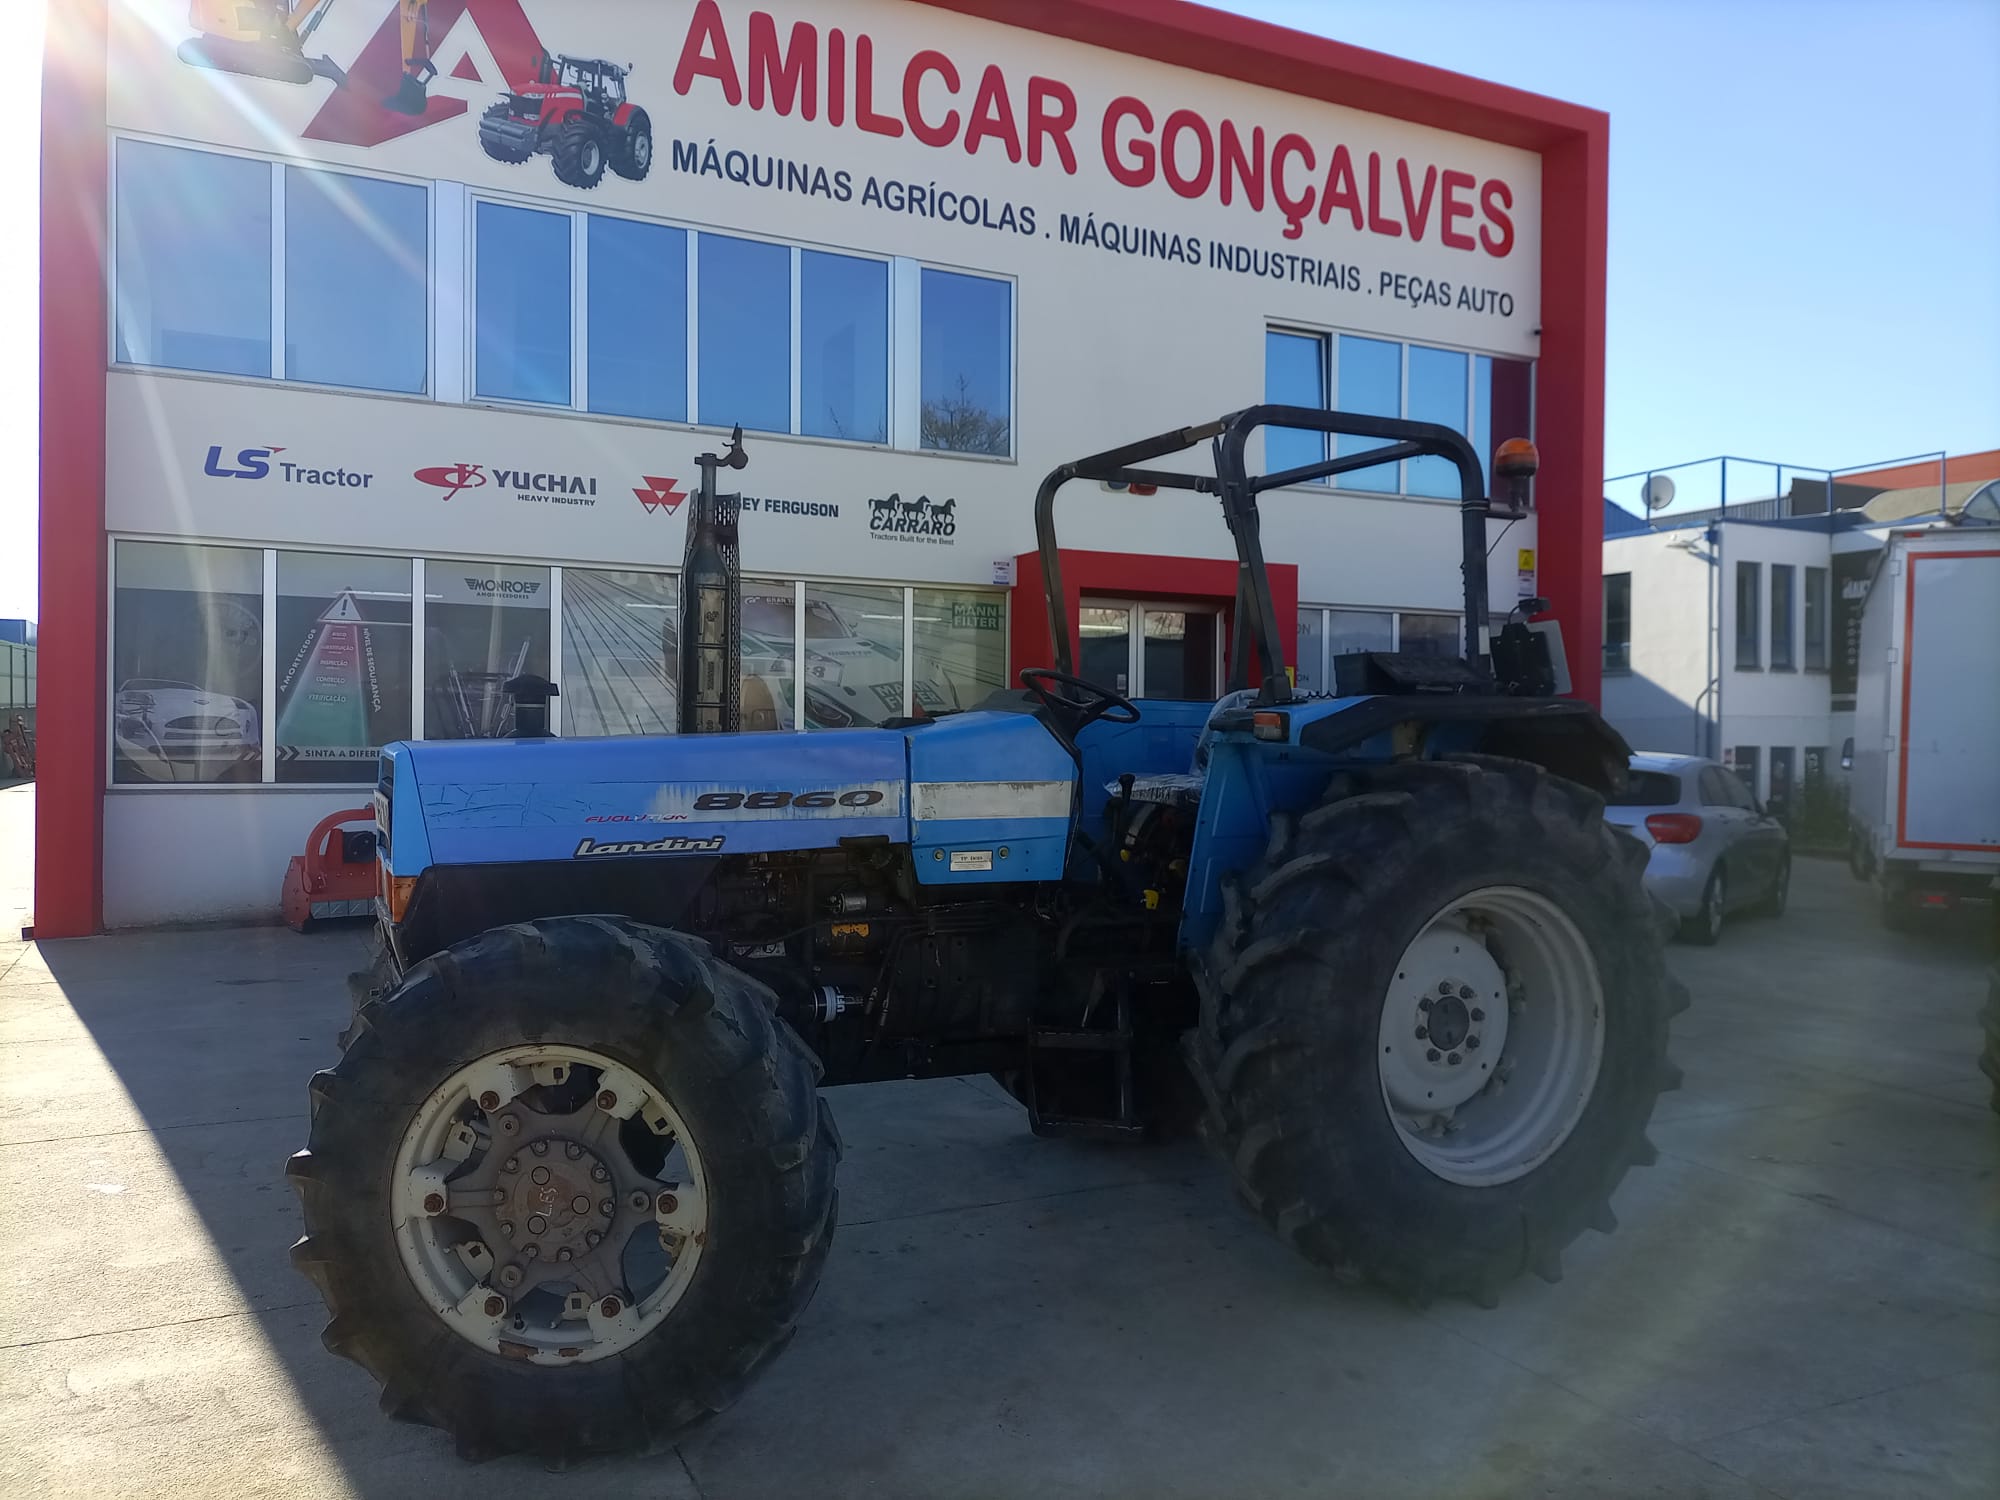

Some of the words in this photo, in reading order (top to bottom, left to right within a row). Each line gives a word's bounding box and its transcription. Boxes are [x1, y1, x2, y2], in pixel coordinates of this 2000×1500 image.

[673, 0, 1077, 175] AMILCAR
[1101, 96, 1514, 258] GONÇALVES
[672, 139, 852, 202] MÁQUINAS
[862, 176, 1036, 236] AGRÍCOLAS
[1059, 213, 1201, 265] MÁQUINAS
[1209, 241, 1361, 291] INDUSTRIAIS
[1380, 271, 1452, 308] PEÇAS
[1457, 286, 1514, 317] AUTO
[204, 445, 271, 480] LS
[279, 462, 374, 488] Tractor
[492, 469, 597, 496] YUCHAI
[517, 493, 550, 504] HEAVY
[551, 496, 596, 507] INDUSTRY
[764, 498, 839, 518] FERGUSON
[869, 515, 956, 537] CARRARO
[870, 532, 898, 542] Tractors
[474, 579, 531, 594] MONROE
[954, 605, 997, 617] MANN
[954, 616, 997, 628] FILTER
[367, 657, 381, 712] SEGURANÇA
[305, 749, 336, 758] SINTA
[339, 749, 346, 758] A
[693, 790, 884, 811] 8860
[575, 836, 725, 857] Landini
